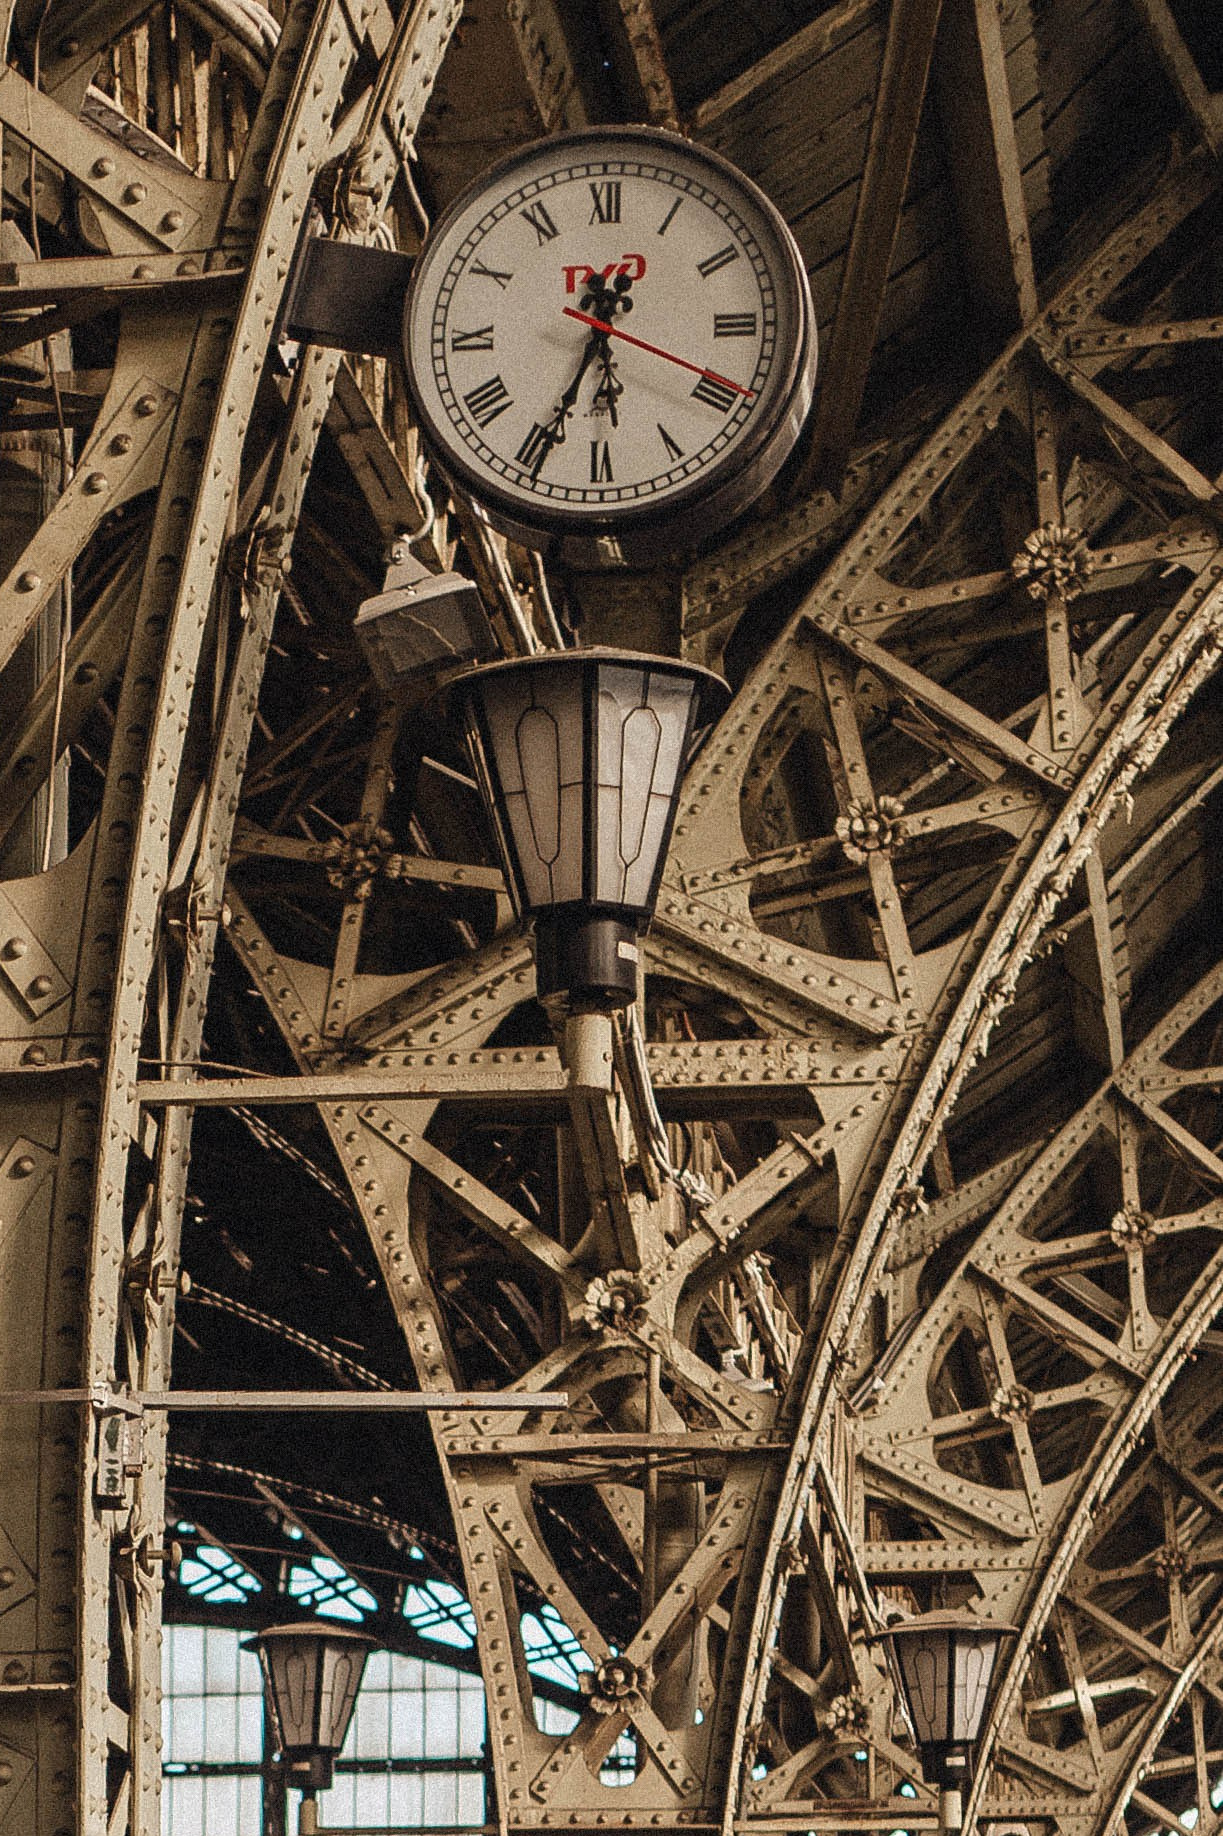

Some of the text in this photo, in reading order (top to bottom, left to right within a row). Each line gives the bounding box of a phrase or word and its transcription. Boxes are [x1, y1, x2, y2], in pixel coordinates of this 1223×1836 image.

[520, 199, 561, 247] XI
[588, 181, 622, 225] XII
[468, 258, 514, 290] X
[696, 243, 741, 280] II
[452, 324, 494, 353] IX
[713, 312, 757, 339] III
[463, 374, 514, 430] VIII
[590, 440, 614, 483] VI
[657, 423, 686, 464] V
